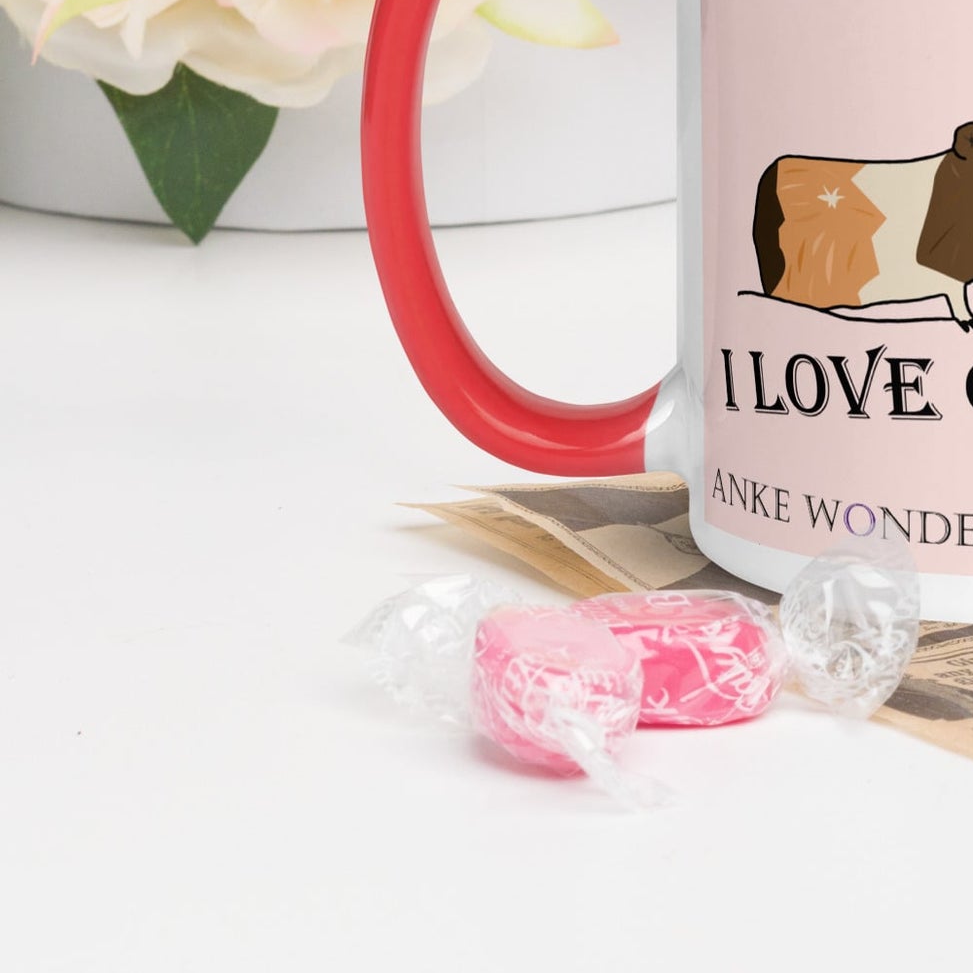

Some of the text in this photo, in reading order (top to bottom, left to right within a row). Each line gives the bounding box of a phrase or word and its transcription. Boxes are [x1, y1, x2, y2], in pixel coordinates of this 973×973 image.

[721, 348, 740, 411] I
[748, 344, 943, 421] LOVE
[712, 467, 791, 524] ANKE
